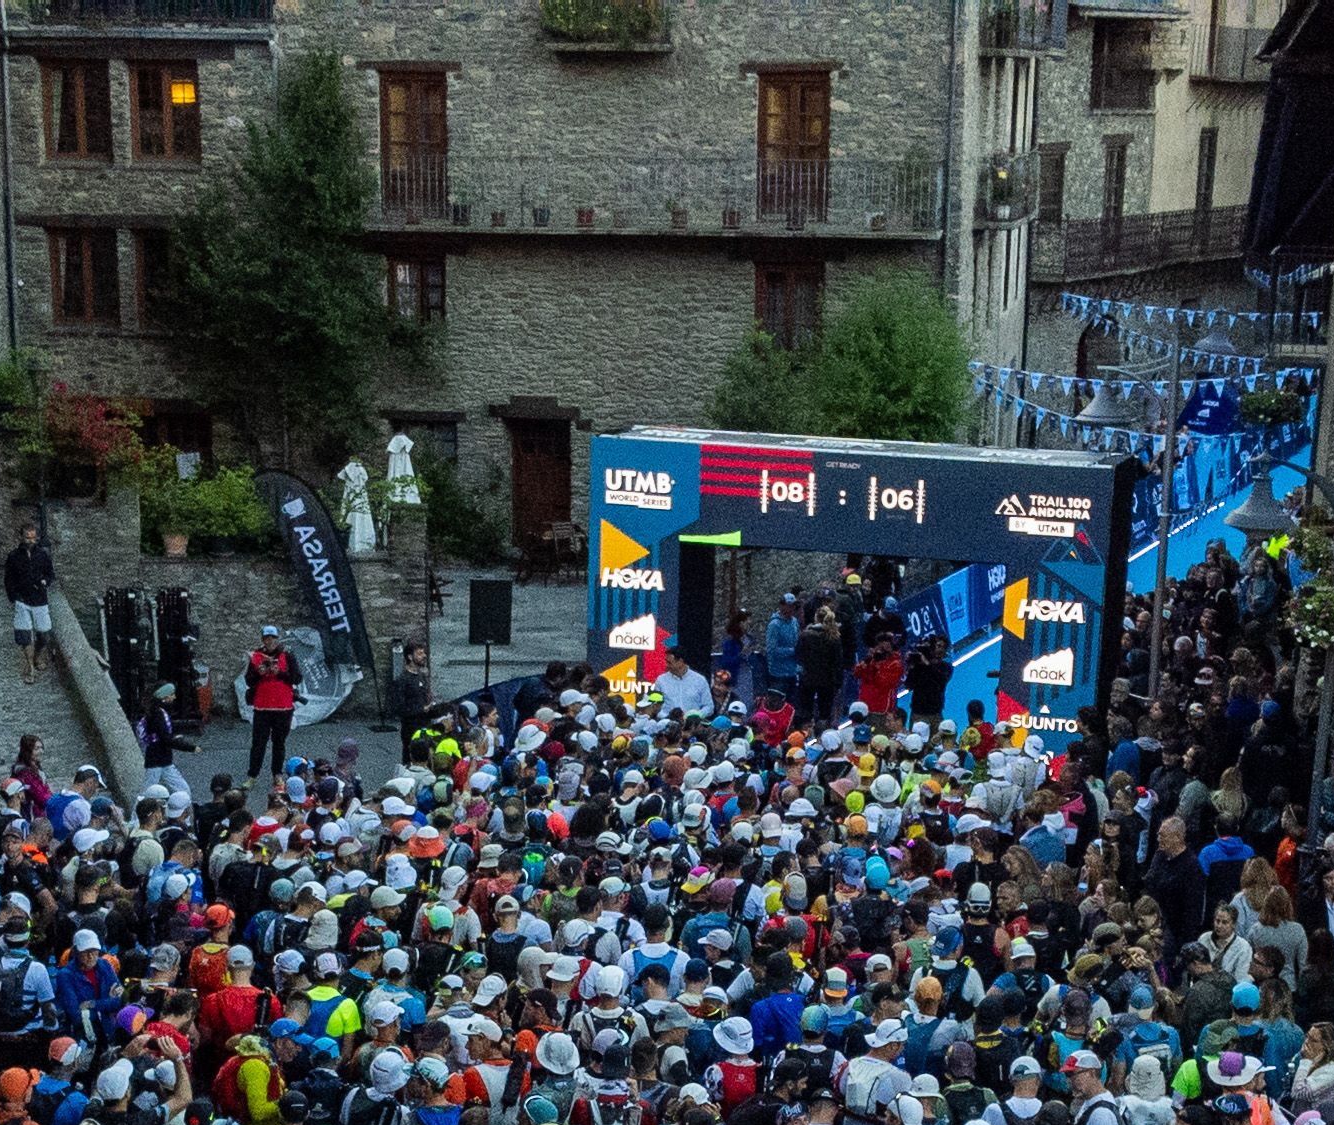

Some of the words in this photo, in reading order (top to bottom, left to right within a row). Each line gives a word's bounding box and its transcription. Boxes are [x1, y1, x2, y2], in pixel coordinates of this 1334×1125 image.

[604, 468, 673, 494] UTMB
[609, 493, 639, 502] WORLD
[641, 497, 668, 507] SERIES
[771, 481, 805, 503] 08
[880, 487, 915, 511] 06
[1028, 494, 1067, 508] TRAIL
[1068, 497, 1092, 509] 100
[1028, 507, 1091, 520] ANDORRA
[1038, 524, 1065, 533] UTMB
[601, 567, 665, 591] HOKA
[1017, 599, 1086, 624] HOKA
[615, 632, 650, 646] näak
[1029, 667, 1066, 681] näak
[609, 680, 655, 694] UUNT
[1010, 714, 1078, 733] SUUNTO
